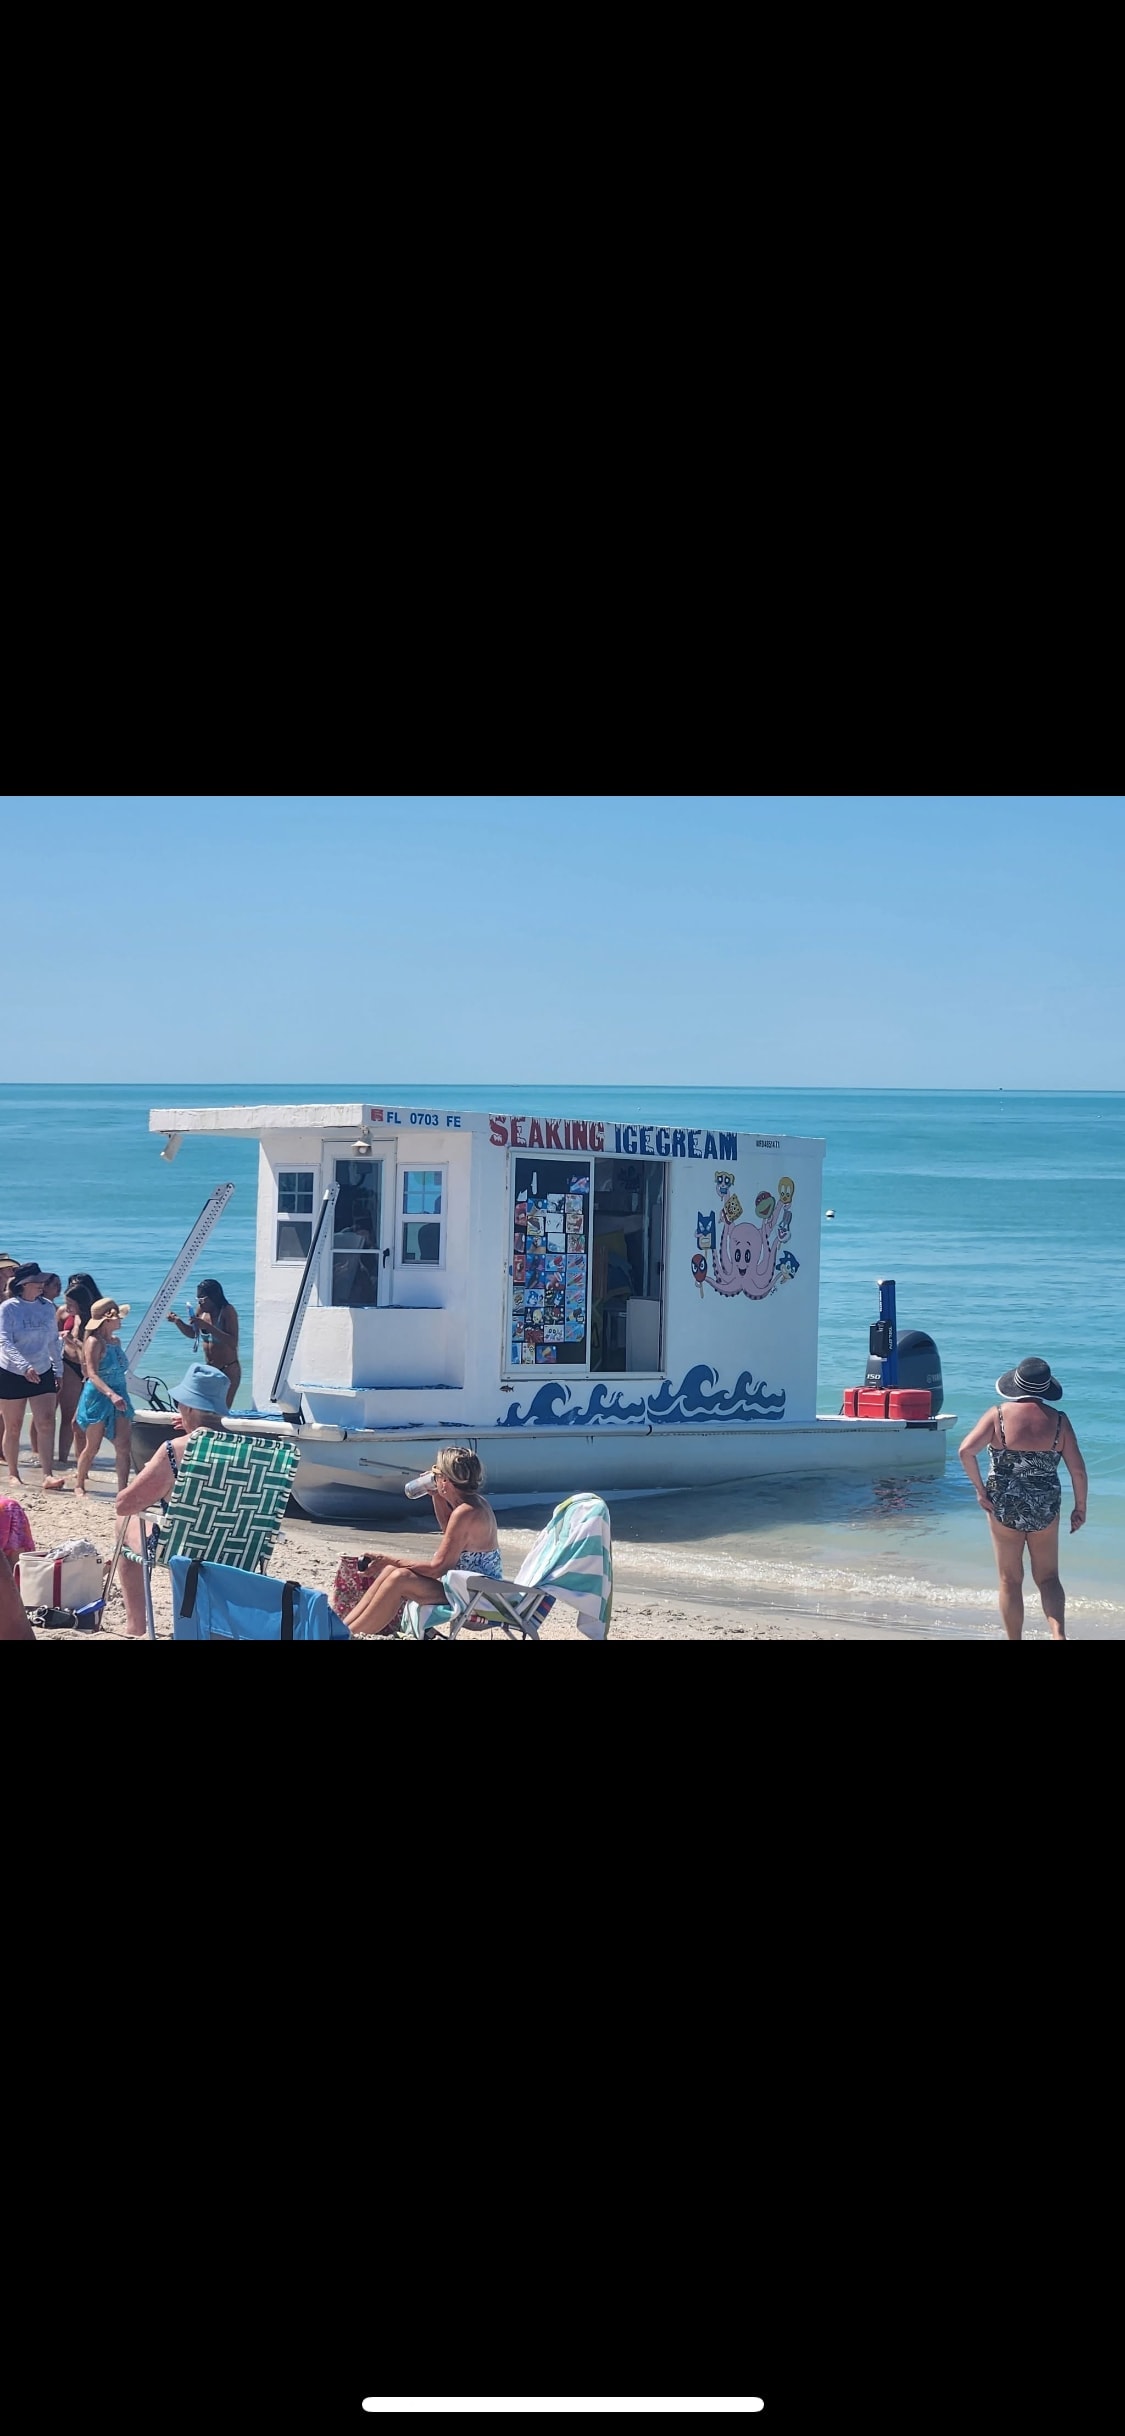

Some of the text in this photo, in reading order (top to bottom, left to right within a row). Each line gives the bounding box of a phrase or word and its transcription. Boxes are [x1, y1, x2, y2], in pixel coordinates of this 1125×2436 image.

[387, 1111, 401, 1124] FL
[410, 1112, 439, 1126] 0703
[446, 1115, 461, 1128] FE
[489, 1114, 738, 1160] SEAKING ICECREAM
